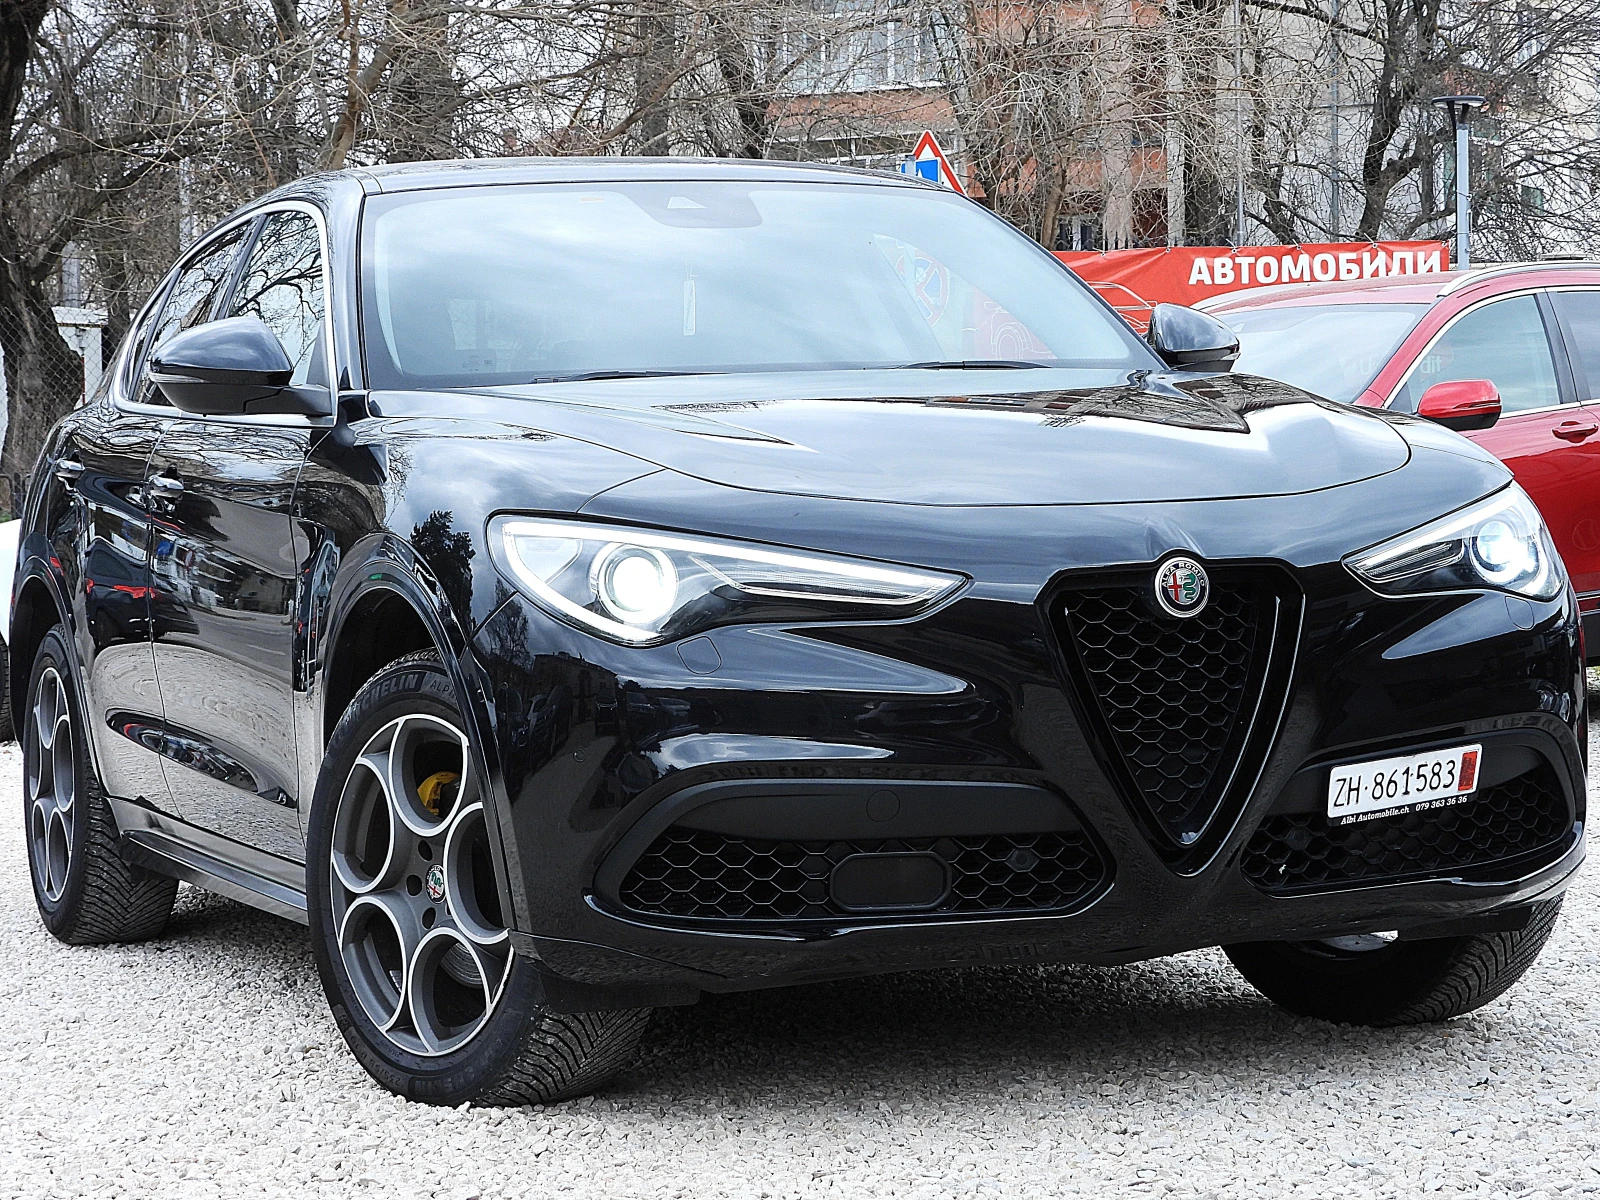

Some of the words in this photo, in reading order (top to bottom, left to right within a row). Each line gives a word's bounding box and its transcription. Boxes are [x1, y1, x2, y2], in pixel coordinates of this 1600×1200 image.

[1189, 251, 1440, 285] АВТОМОБИЛИ
[1162, 565, 1177, 588] ALFA
[1340, 814, 1357, 826] Albi
[1357, 806, 1410, 823] Automobile.ch
[1415, 800, 1430, 812] 079
[1431, 798, 1445, 809] 363
[1446, 796, 1457, 807] 36
[1458, 795, 1468, 804] 36
